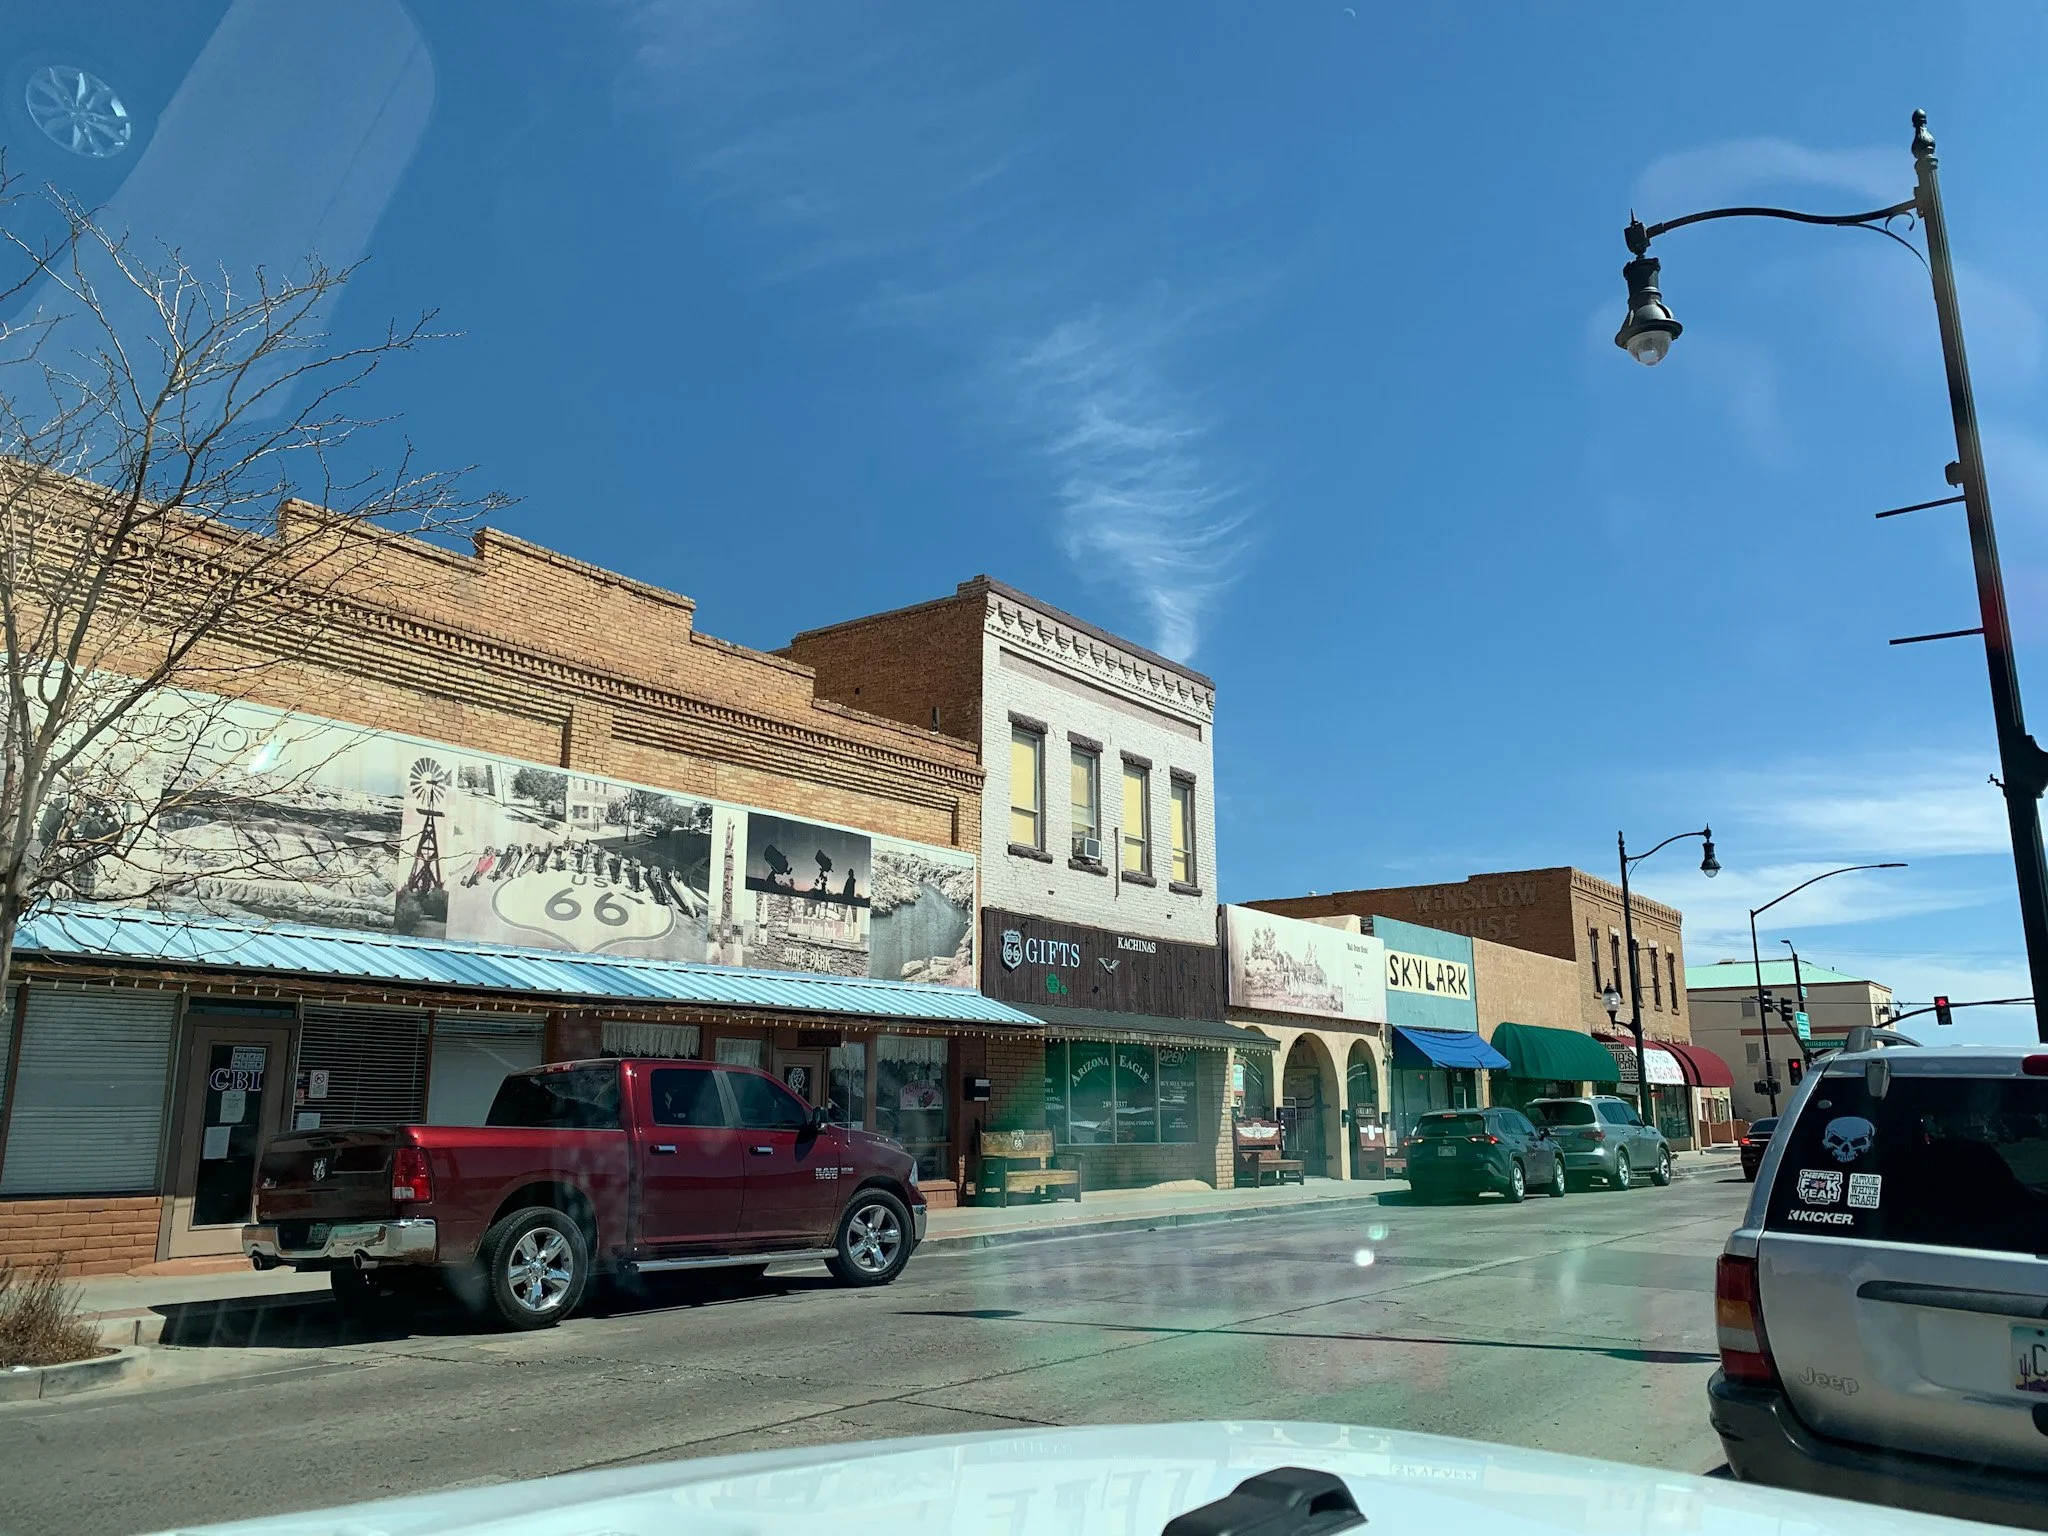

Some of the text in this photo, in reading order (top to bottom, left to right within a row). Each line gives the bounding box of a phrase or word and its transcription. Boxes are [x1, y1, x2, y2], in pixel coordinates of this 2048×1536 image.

[571, 874, 608, 888] US
[1411, 881, 1537, 912] WINSLOW
[545, 888, 629, 926] 66
[1006, 937, 1080, 968] 66 GIFTS
[1118, 936, 1157, 954] KACHINAS
[784, 947, 831, 973] STATE PARK
[1389, 954, 1468, 996] SKYLARK
[1158, 1050, 1185, 1065] OPEN
[210, 1068, 262, 1091] CBI
[1014, 1139, 1023, 1148] 66
[1800, 1188, 1838, 1200] YEAH
[1850, 1194, 1878, 1207] TRASH
[1851, 1185, 1879, 1196] WHITE
[1799, 1366, 1860, 1396] Jeep
